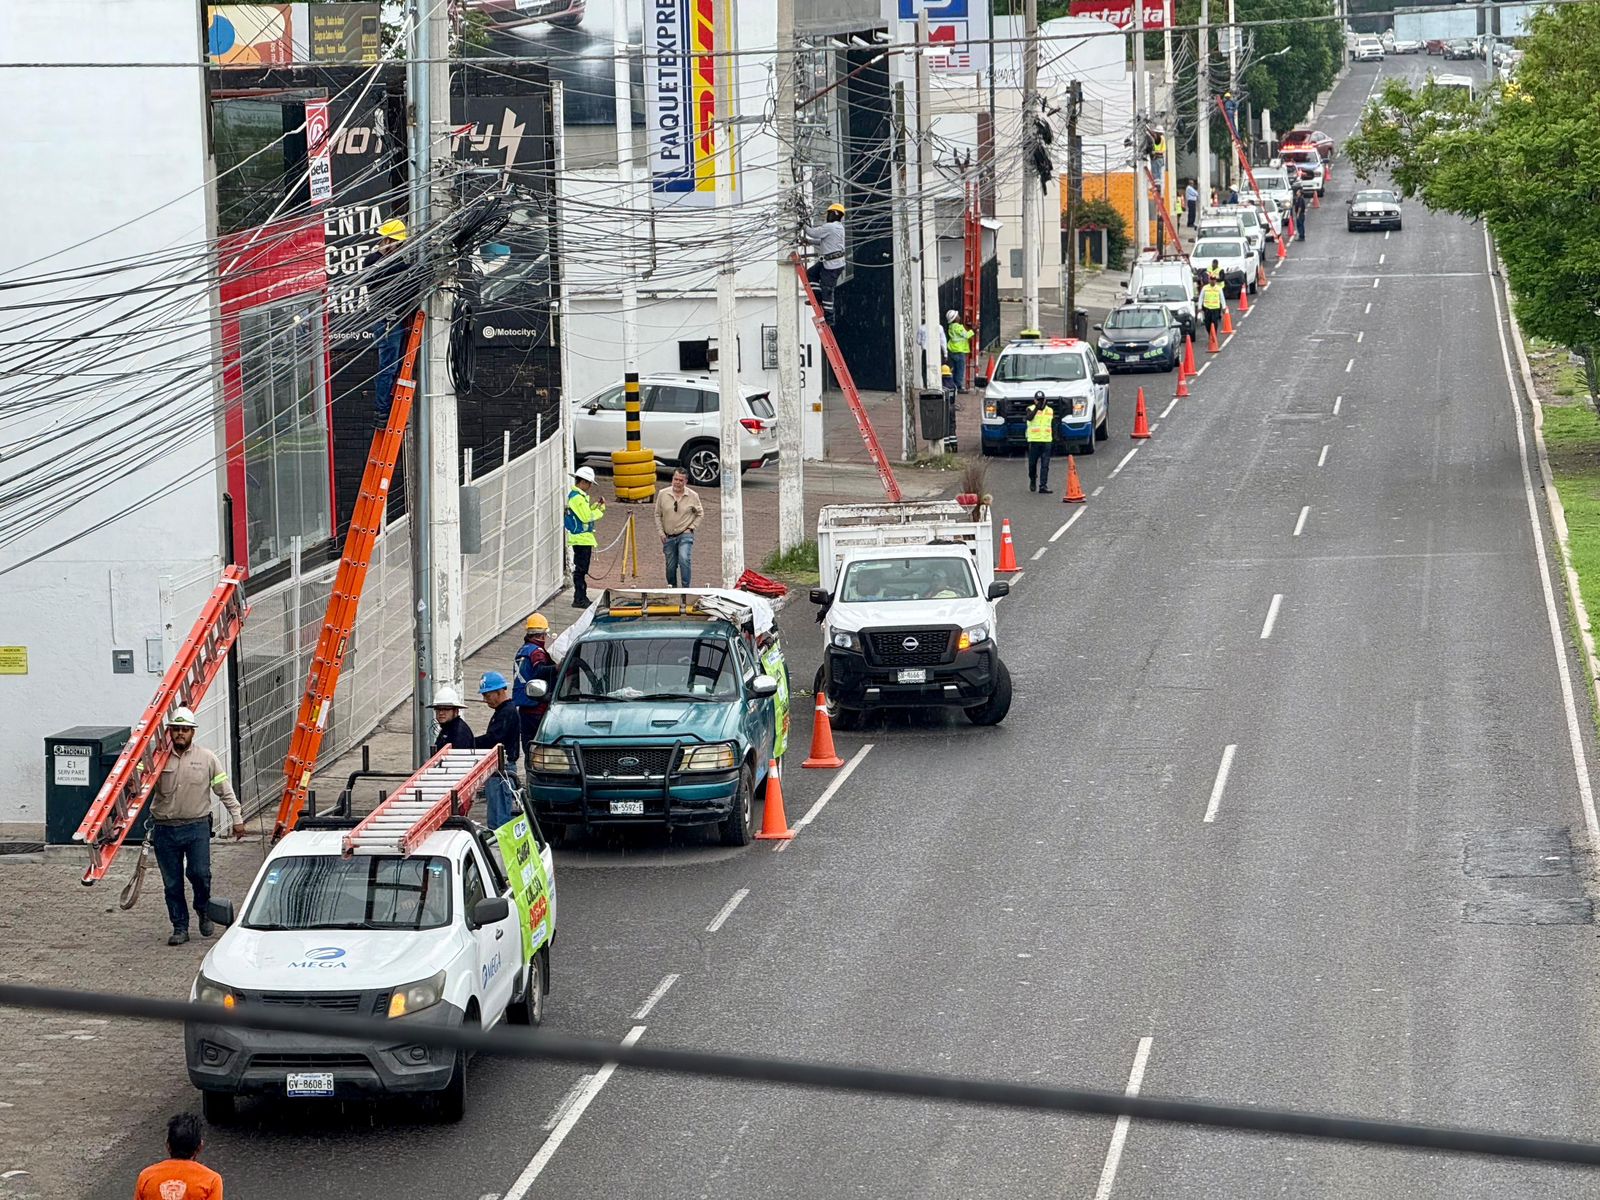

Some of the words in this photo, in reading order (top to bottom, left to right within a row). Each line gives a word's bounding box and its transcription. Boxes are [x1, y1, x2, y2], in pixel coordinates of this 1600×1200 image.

[1076, 6, 1163, 24] estafta
[656, 0, 680, 160] PAQUETEXPRE
[288, 961, 347, 969] MEGA
